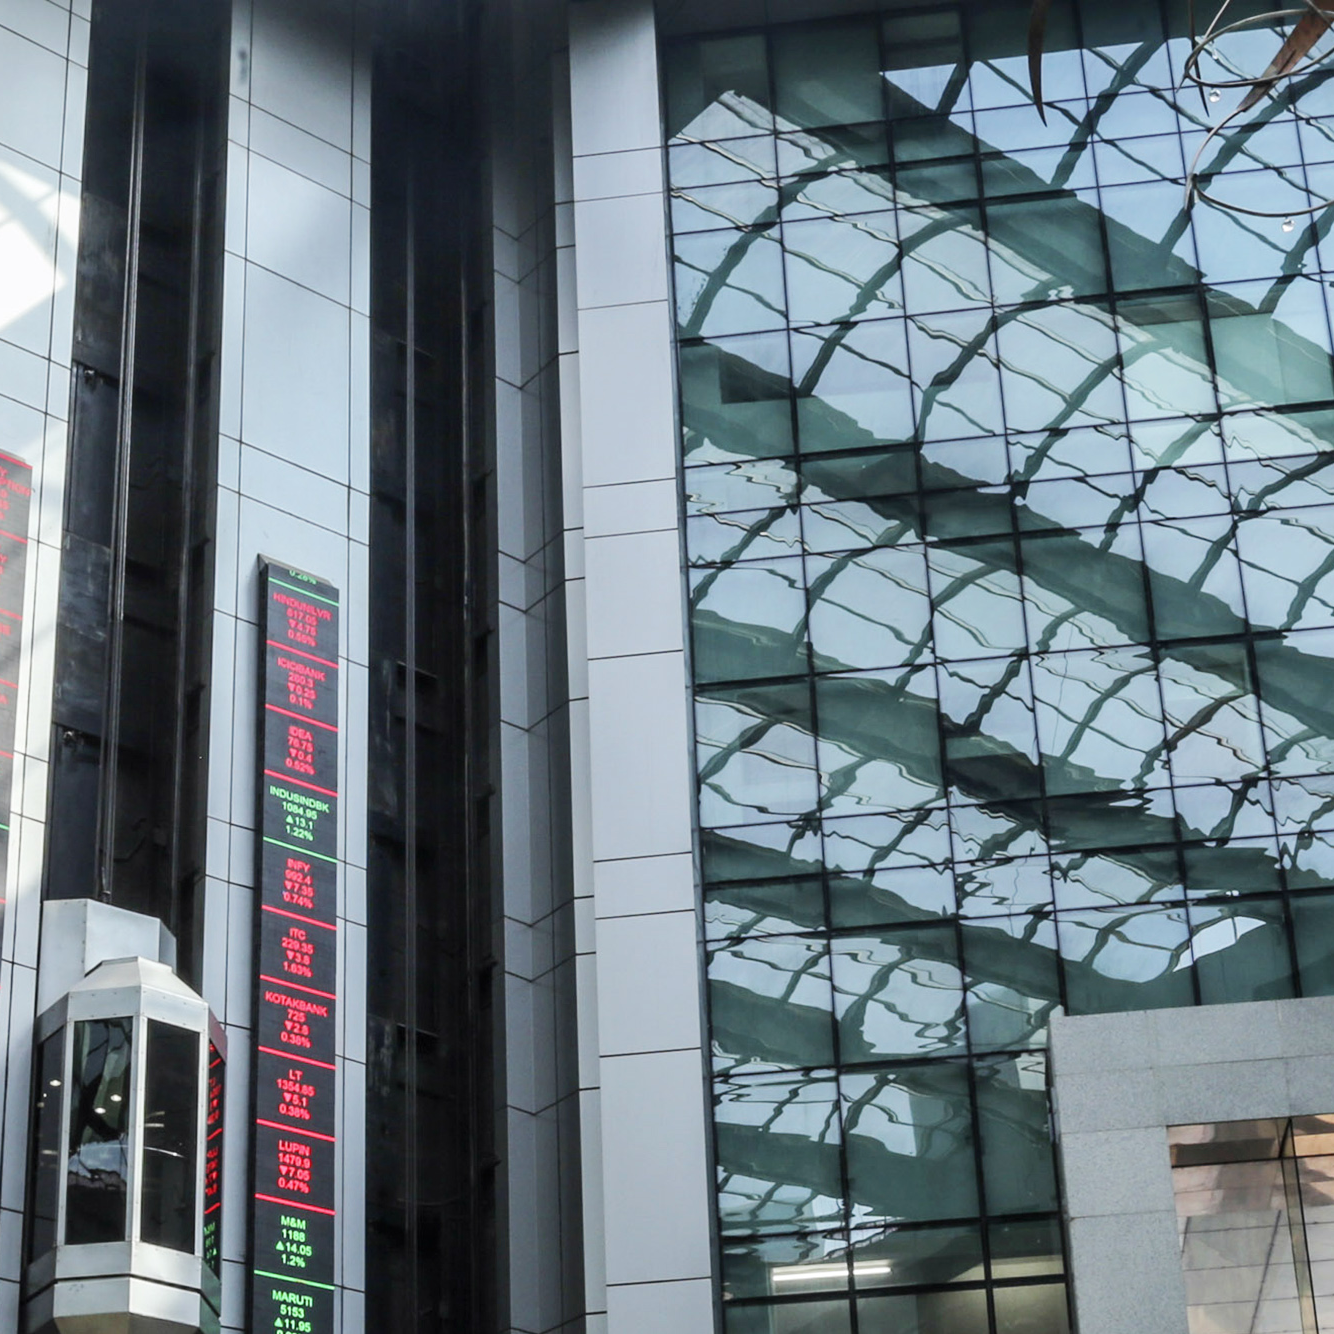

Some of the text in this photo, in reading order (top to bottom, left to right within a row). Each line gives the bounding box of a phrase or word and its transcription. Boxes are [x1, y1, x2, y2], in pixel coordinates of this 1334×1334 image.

[270, 786, 329, 813] INDUSINDBK
[282, 801, 317, 820] 1084.95
[294, 816, 313, 829] 13.1
[285, 825, 314, 840] 1.22%
[286, 858, 310, 871] INFY
[292, 881, 314, 897] 7.35
[283, 891, 314, 908] 0.74%
[288, 926, 307, 941] ITC
[264, 992, 328, 1016] KOTAKBANK
[287, 1008, 306, 1023] 725
[288, 1069, 303, 1081] LT
[290, 1092, 308, 1106] 5.1
[277, 1140, 311, 1156] LUPIN
[277, 1151, 311, 1169] 1479.9
[288, 1166, 311, 1181] 7.05
[276, 1176, 310, 1193] 0.47%
[280, 1217, 306, 1230] M&M
[281, 1228, 307, 1242] 1188
[284, 1241, 313, 1256] 14.05
[280, 1253, 306, 1268] 1.2%
[271, 1290, 313, 1308] MARUTI
[279, 1303, 305, 1318] 5153
[283, 1318, 312, 1332] 11.95
